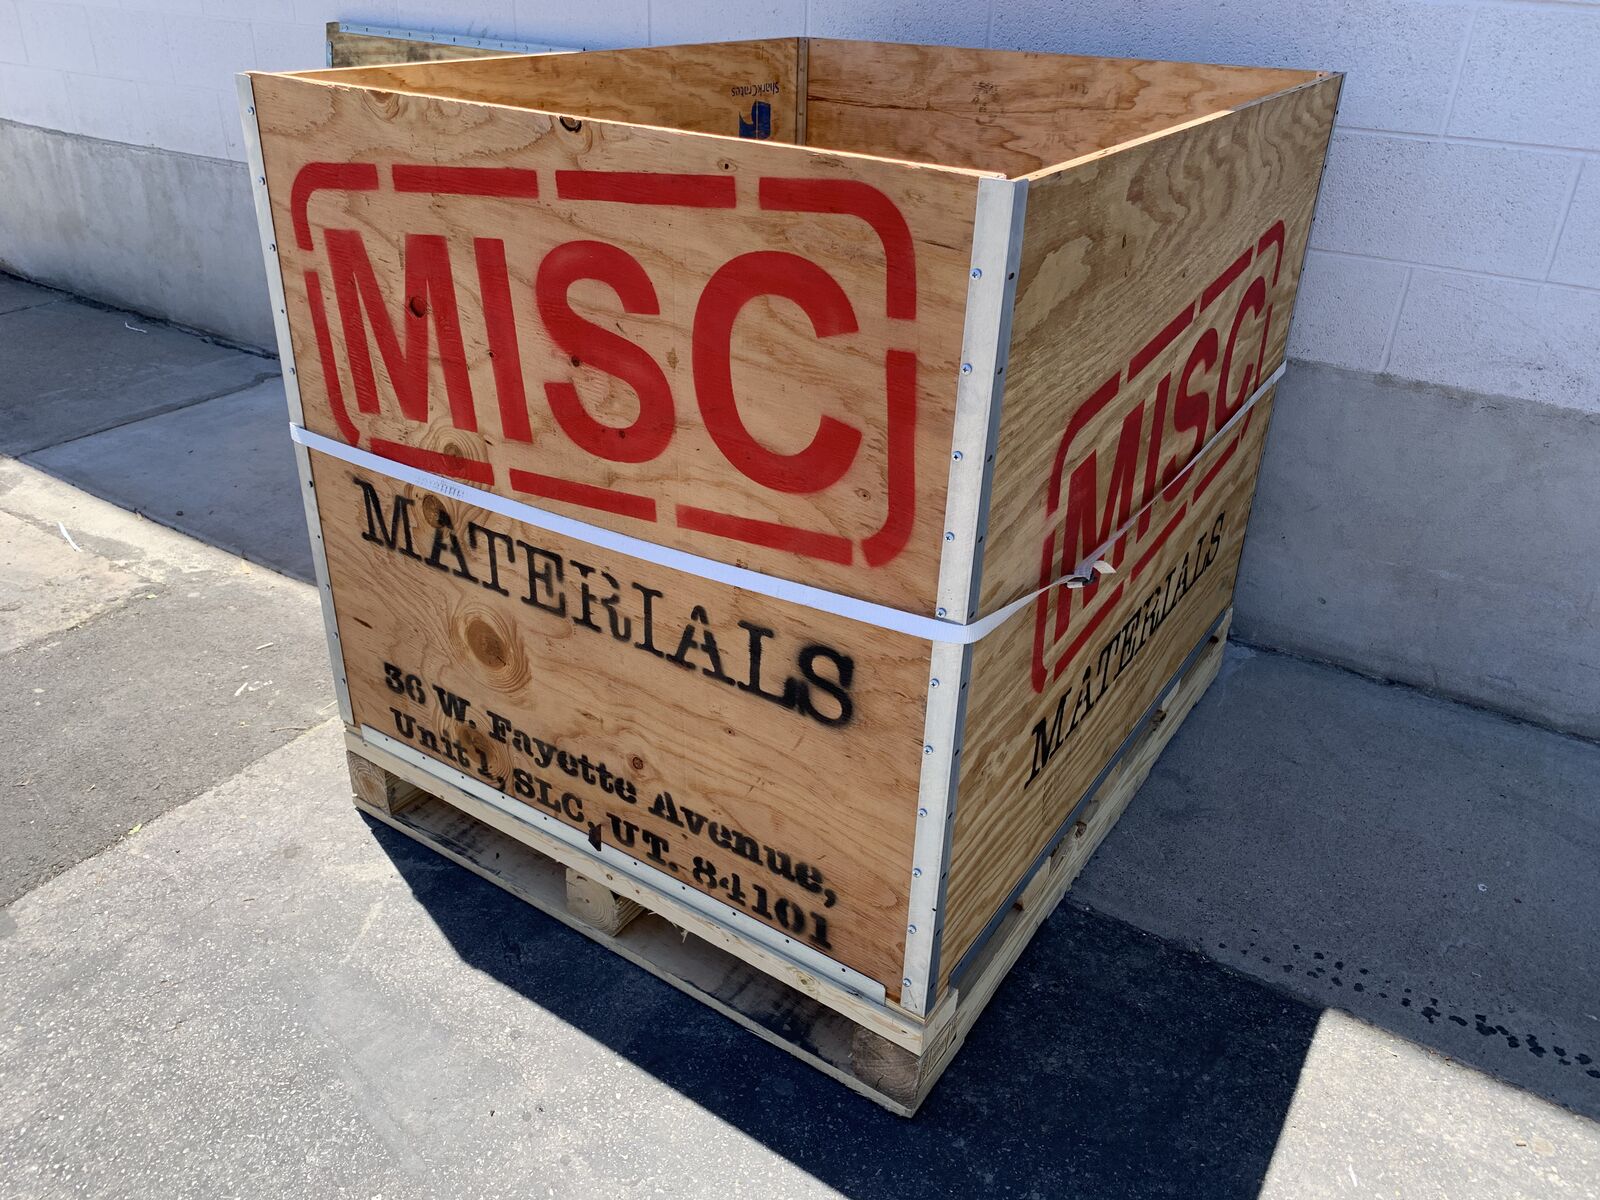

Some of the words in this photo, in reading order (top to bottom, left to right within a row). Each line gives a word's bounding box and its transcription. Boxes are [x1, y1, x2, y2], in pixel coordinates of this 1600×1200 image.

[731, 81, 780, 97] SharkCrates
[323, 228, 863, 495] MISC
[1053, 275, 1266, 647] MISC
[353, 476, 857, 729] MATERIALS
[1024, 510, 1226, 789] MATERIALS
[384, 662, 426, 705] 36
[433, 683, 478, 729] W.
[486, 709, 637, 804] Fayette
[648, 791, 837, 909] Avenue,
[389, 706, 471, 768] Unit
[606, 812, 678, 872] UT.
[693, 856, 833, 950] 84101
